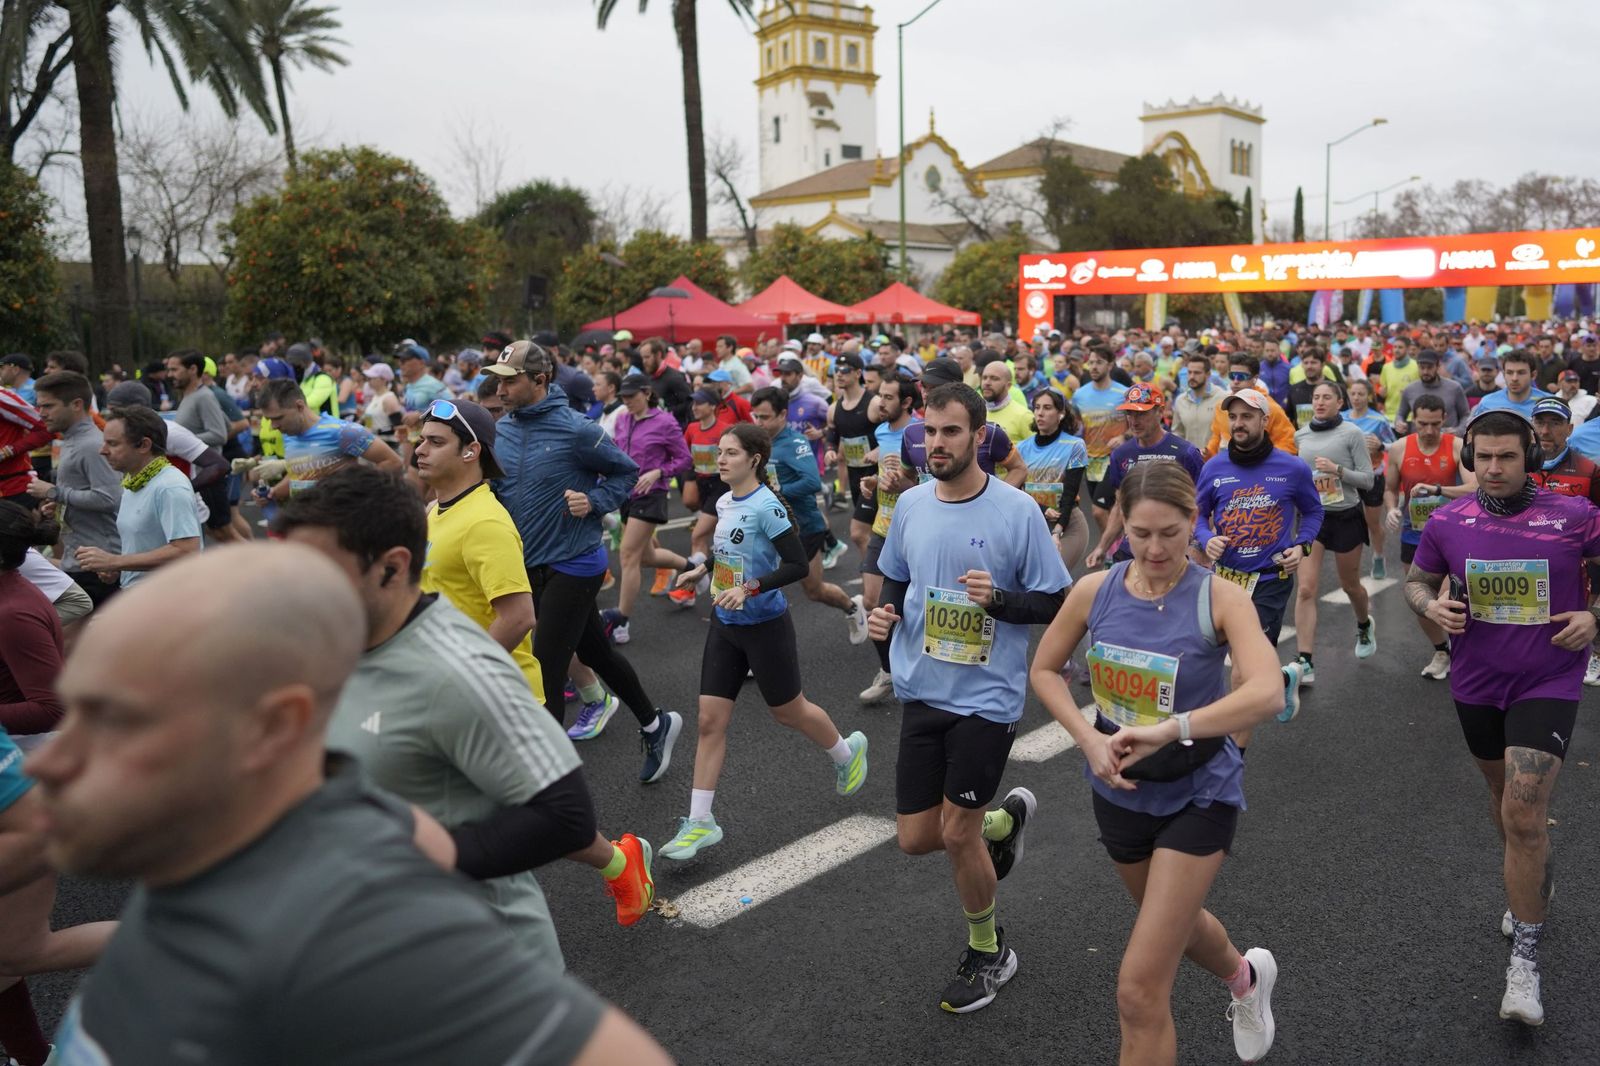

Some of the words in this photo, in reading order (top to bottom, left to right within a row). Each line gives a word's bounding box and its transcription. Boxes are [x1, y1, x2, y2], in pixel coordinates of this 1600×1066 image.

[1478, 576, 1529, 596] 9009
[929, 604, 984, 634] 10303
[1093, 662, 1158, 703] 13094
